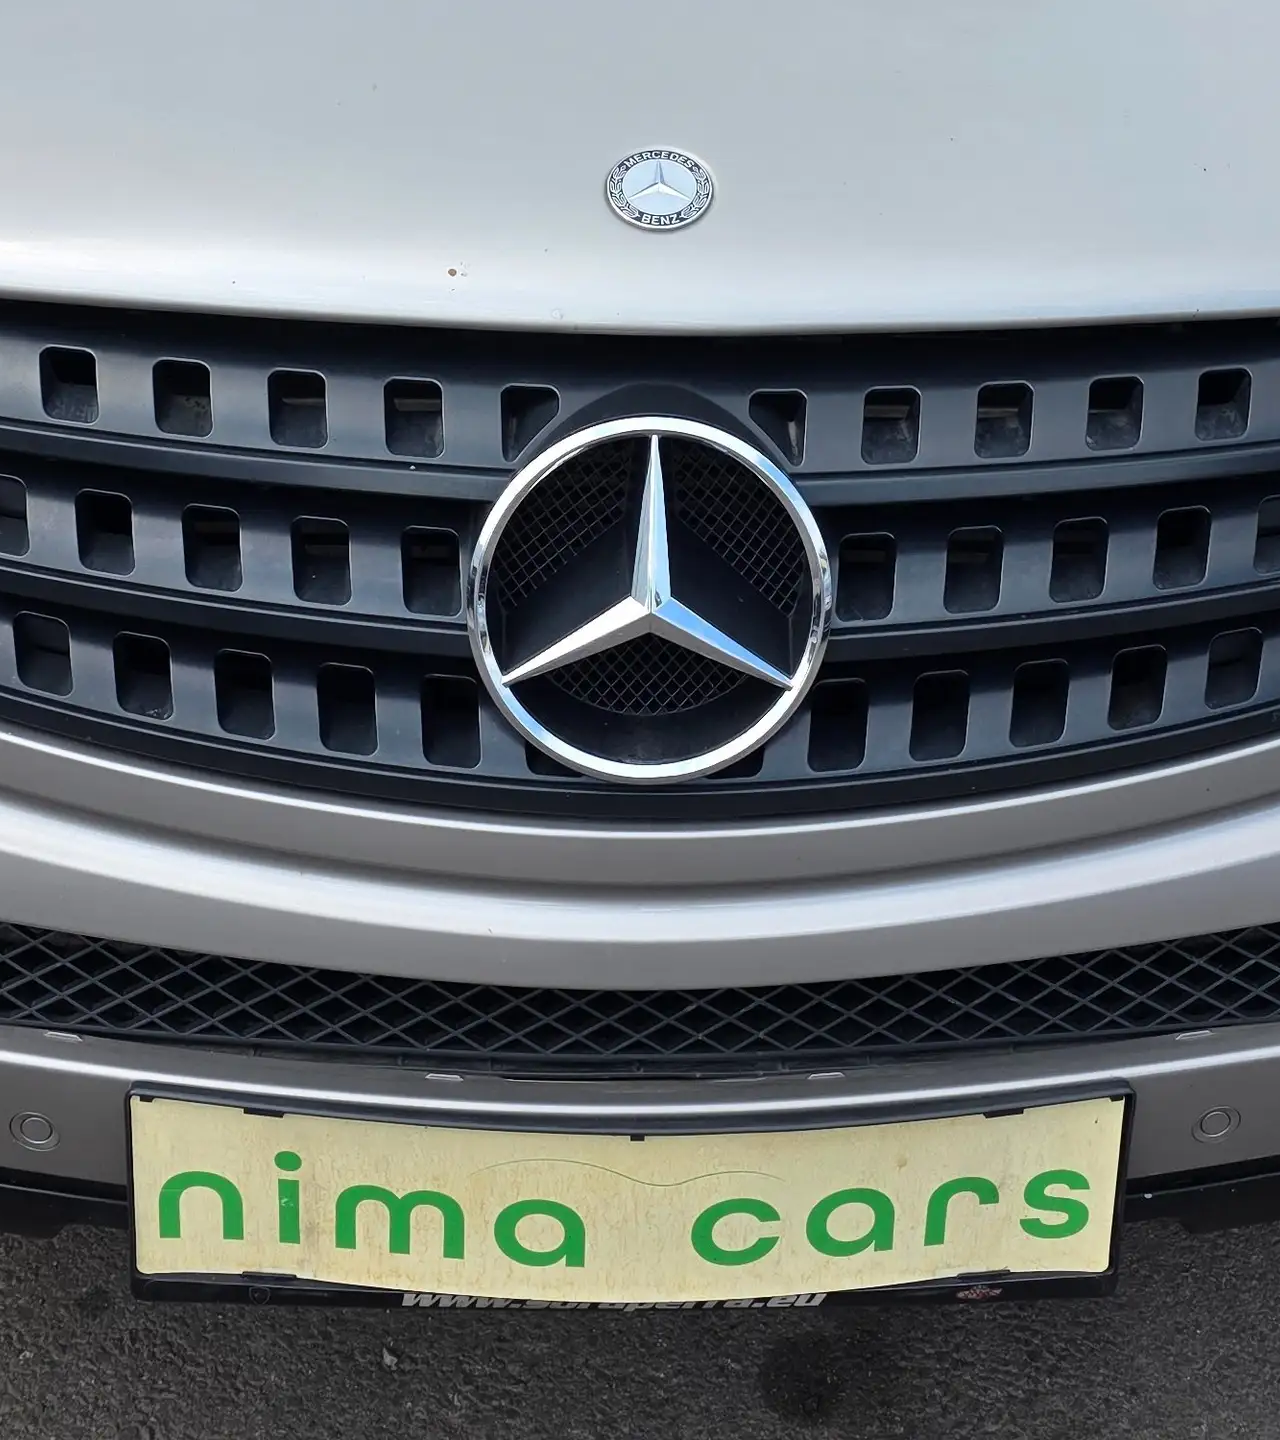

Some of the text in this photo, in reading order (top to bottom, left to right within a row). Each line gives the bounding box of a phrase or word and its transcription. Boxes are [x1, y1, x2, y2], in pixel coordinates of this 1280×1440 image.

[624, 151, 695, 168] MERCEDES
[641, 214, 680, 226] BENZ
[158, 1151, 1090, 1268] nima cars
